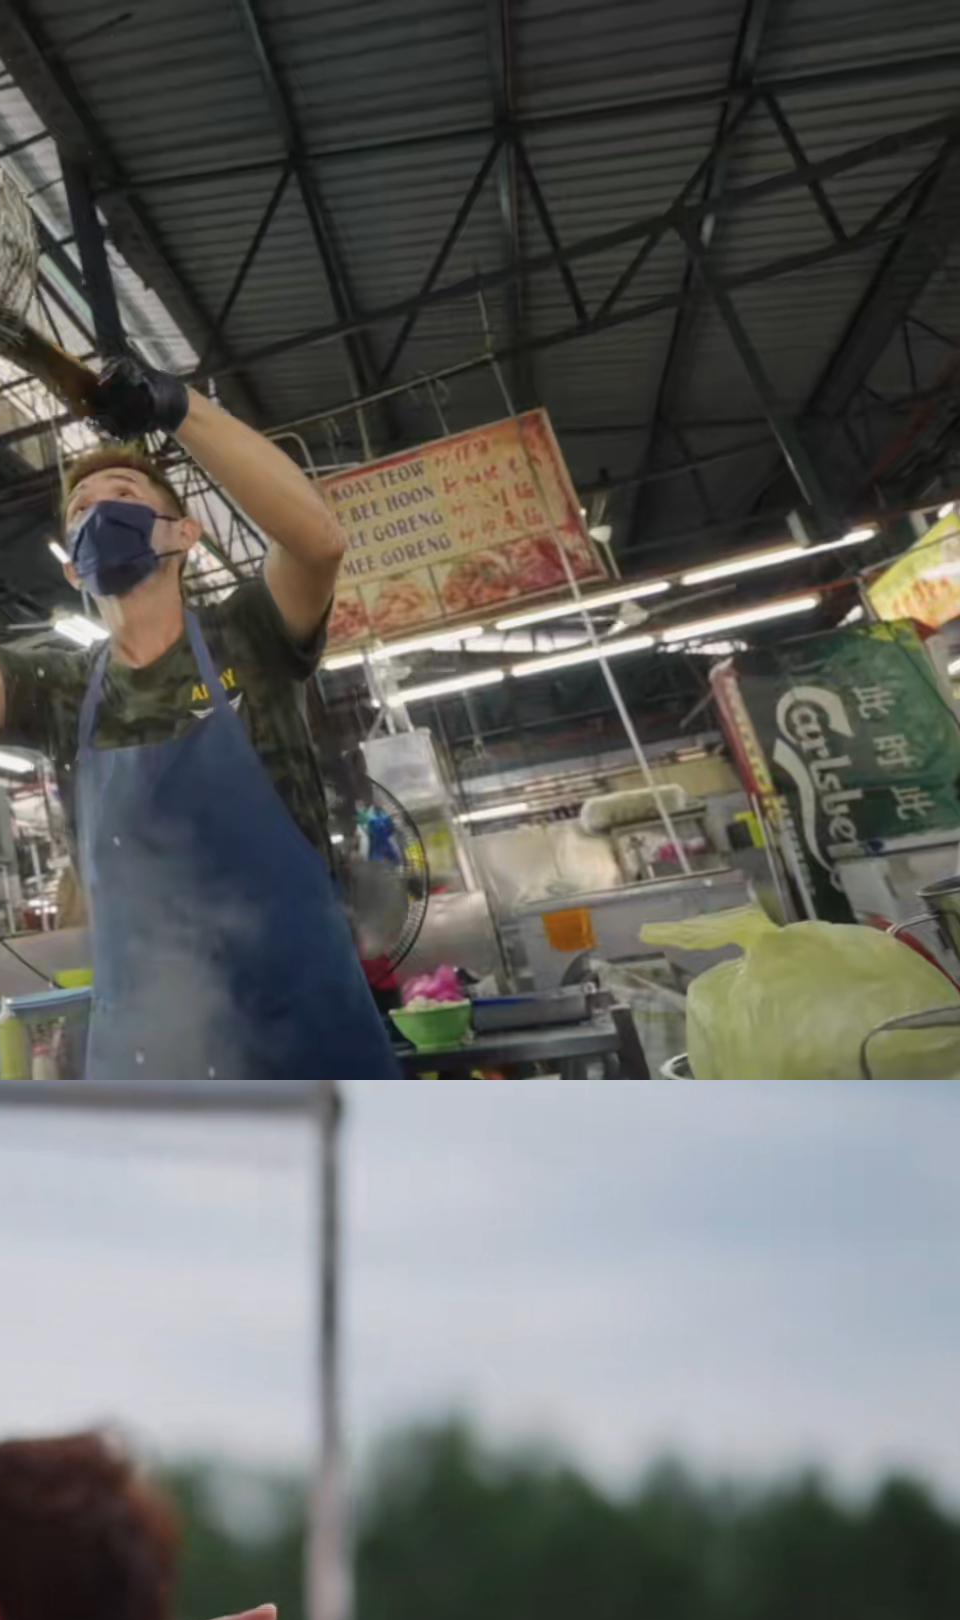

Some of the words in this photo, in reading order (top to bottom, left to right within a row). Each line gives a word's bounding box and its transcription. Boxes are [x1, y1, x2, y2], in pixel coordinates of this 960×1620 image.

[376, 461, 425, 489] TEOW
[350, 501, 382, 523] BEE
[385, 485, 437, 513] HOON
[373, 509, 444, 543] GORENG
[343, 556, 375, 576] MEE
[381, 533, 452, 567] GORENG
